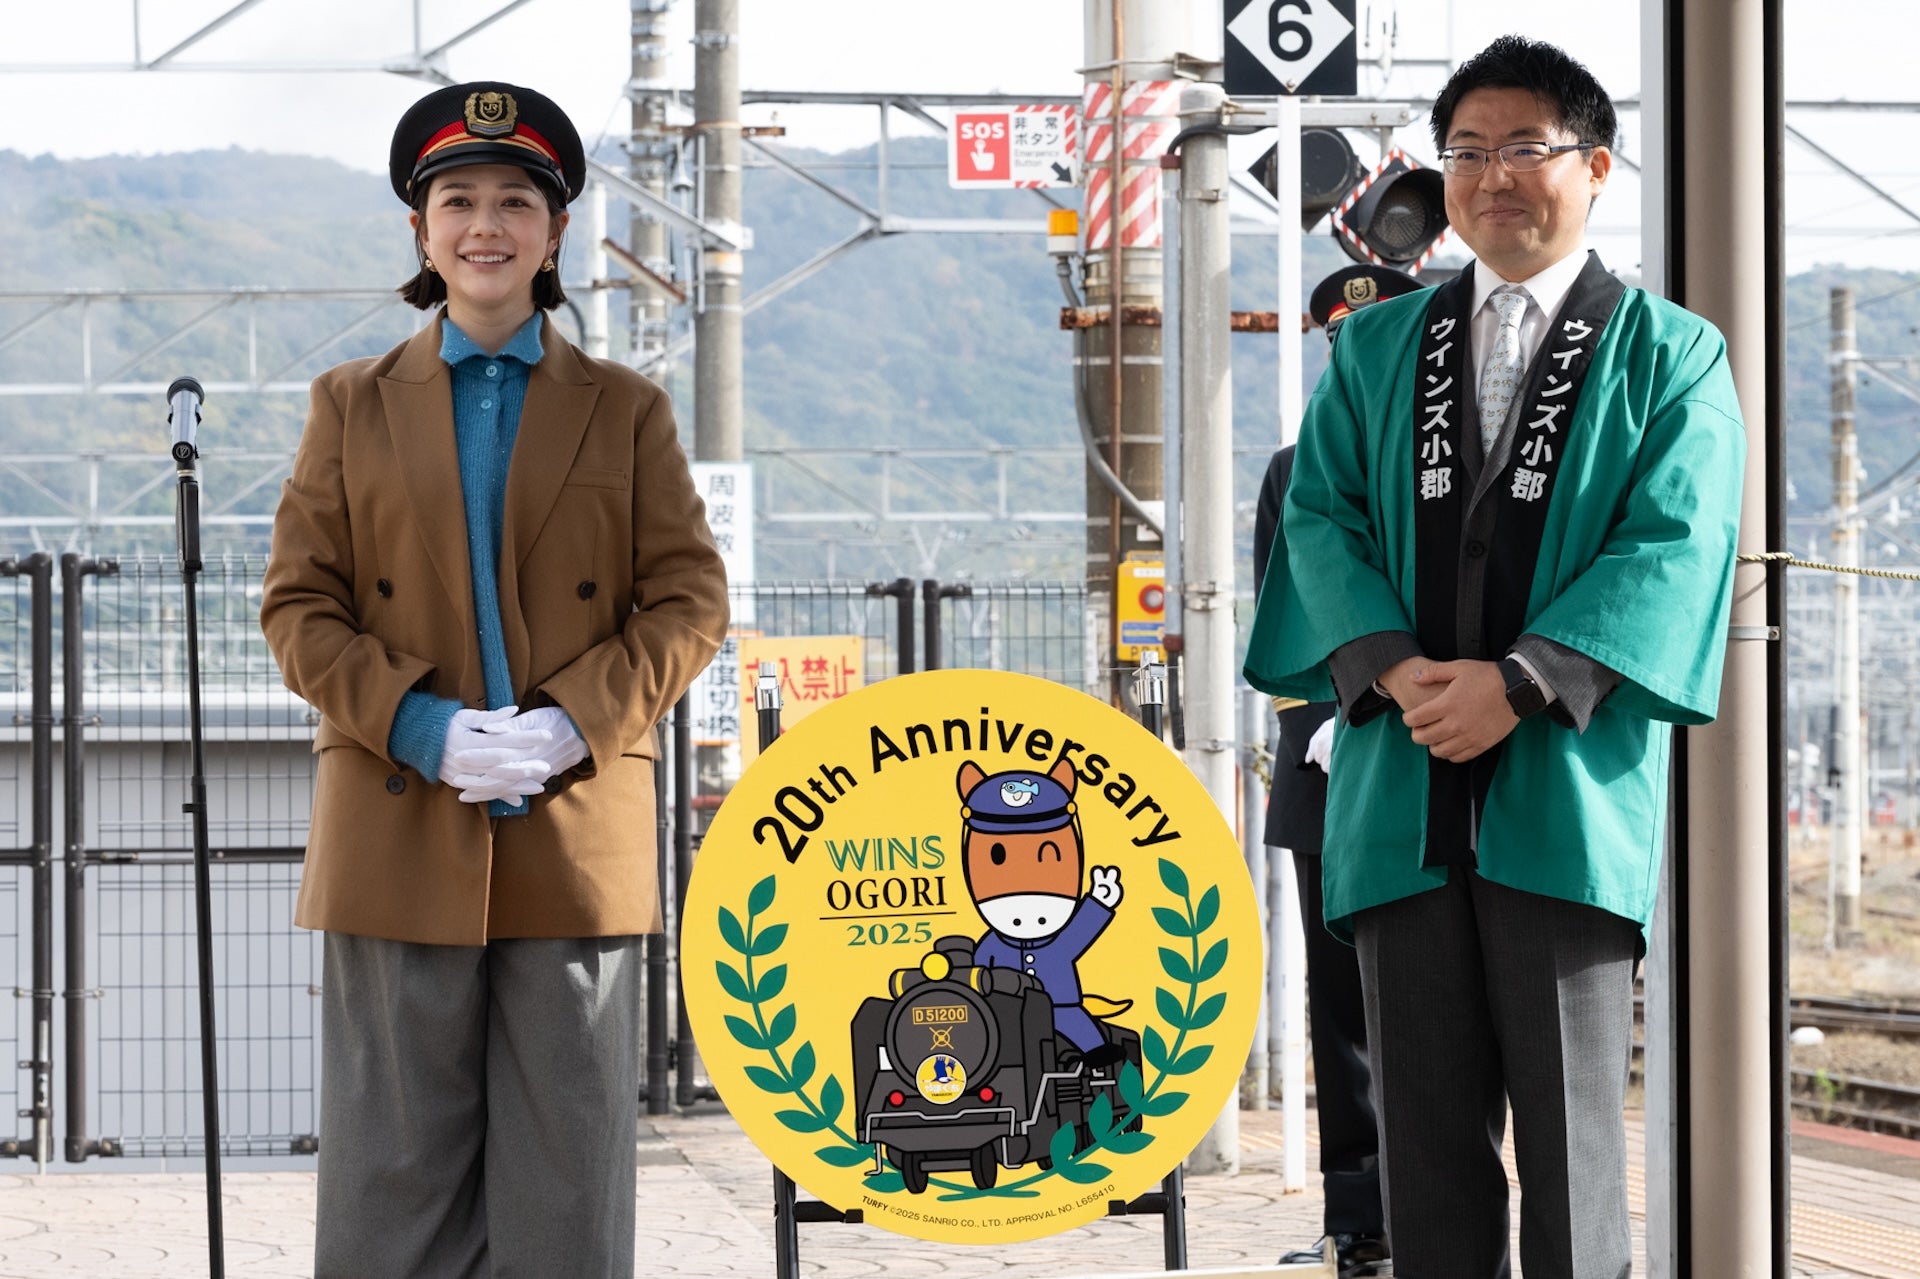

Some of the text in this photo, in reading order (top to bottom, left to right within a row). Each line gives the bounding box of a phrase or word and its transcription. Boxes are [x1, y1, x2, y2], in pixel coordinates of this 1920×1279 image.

[1269, 0, 1313, 62] 6
[961, 122, 1005, 139] SOS
[1015, 132, 1059, 146] ボタン
[1420, 317, 1457, 501] ウインズ小郡
[1511, 318, 1593, 502] ウインズ小郡
[753, 706, 1182, 865] 20th Anniversary
[824, 835, 946, 872] WINS
[826, 876, 948, 911] OGORI
[846, 921, 933, 947] 2025
[862, 1195, 889, 1211] TURFY
[922, 1214, 959, 1227] SANRIO
[982, 1218, 1003, 1228] LTD.
[1006, 1209, 1057, 1226] APPROVAL
[1058, 1203, 1075, 1214] NO.
[1076, 1184, 1116, 1208] L655410
